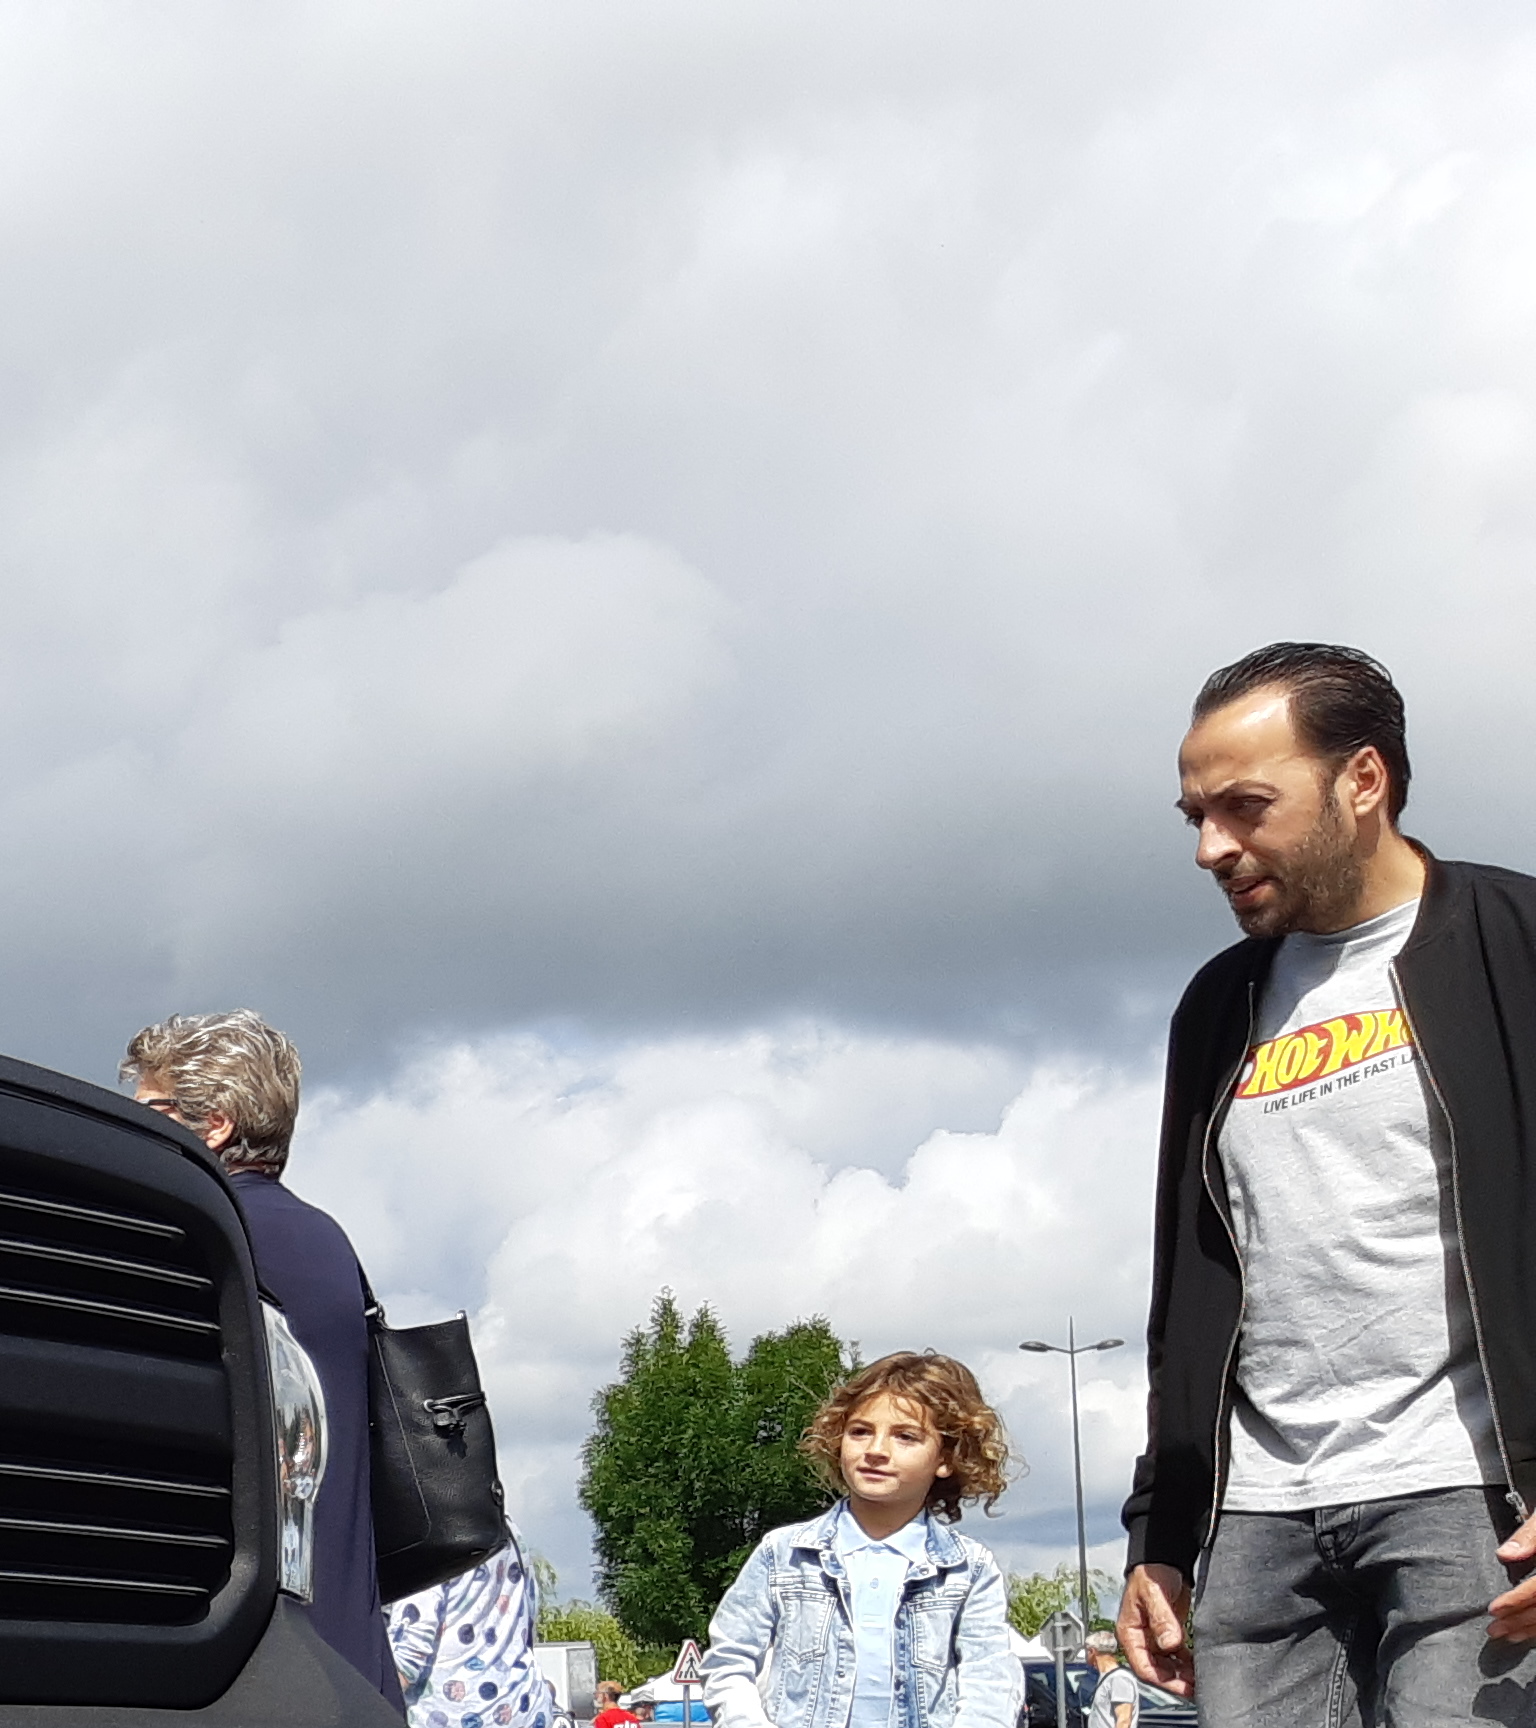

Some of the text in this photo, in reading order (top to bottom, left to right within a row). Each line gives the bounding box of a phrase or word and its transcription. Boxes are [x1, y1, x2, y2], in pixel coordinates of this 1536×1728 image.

[1263, 1097, 1289, 1114] LIVE
[1291, 1087, 1317, 1106] LIFE
[1319, 1080, 1333, 1096] IN
[1336, 1070, 1361, 1090] THE
[1363, 1056, 1396, 1078] FAST
